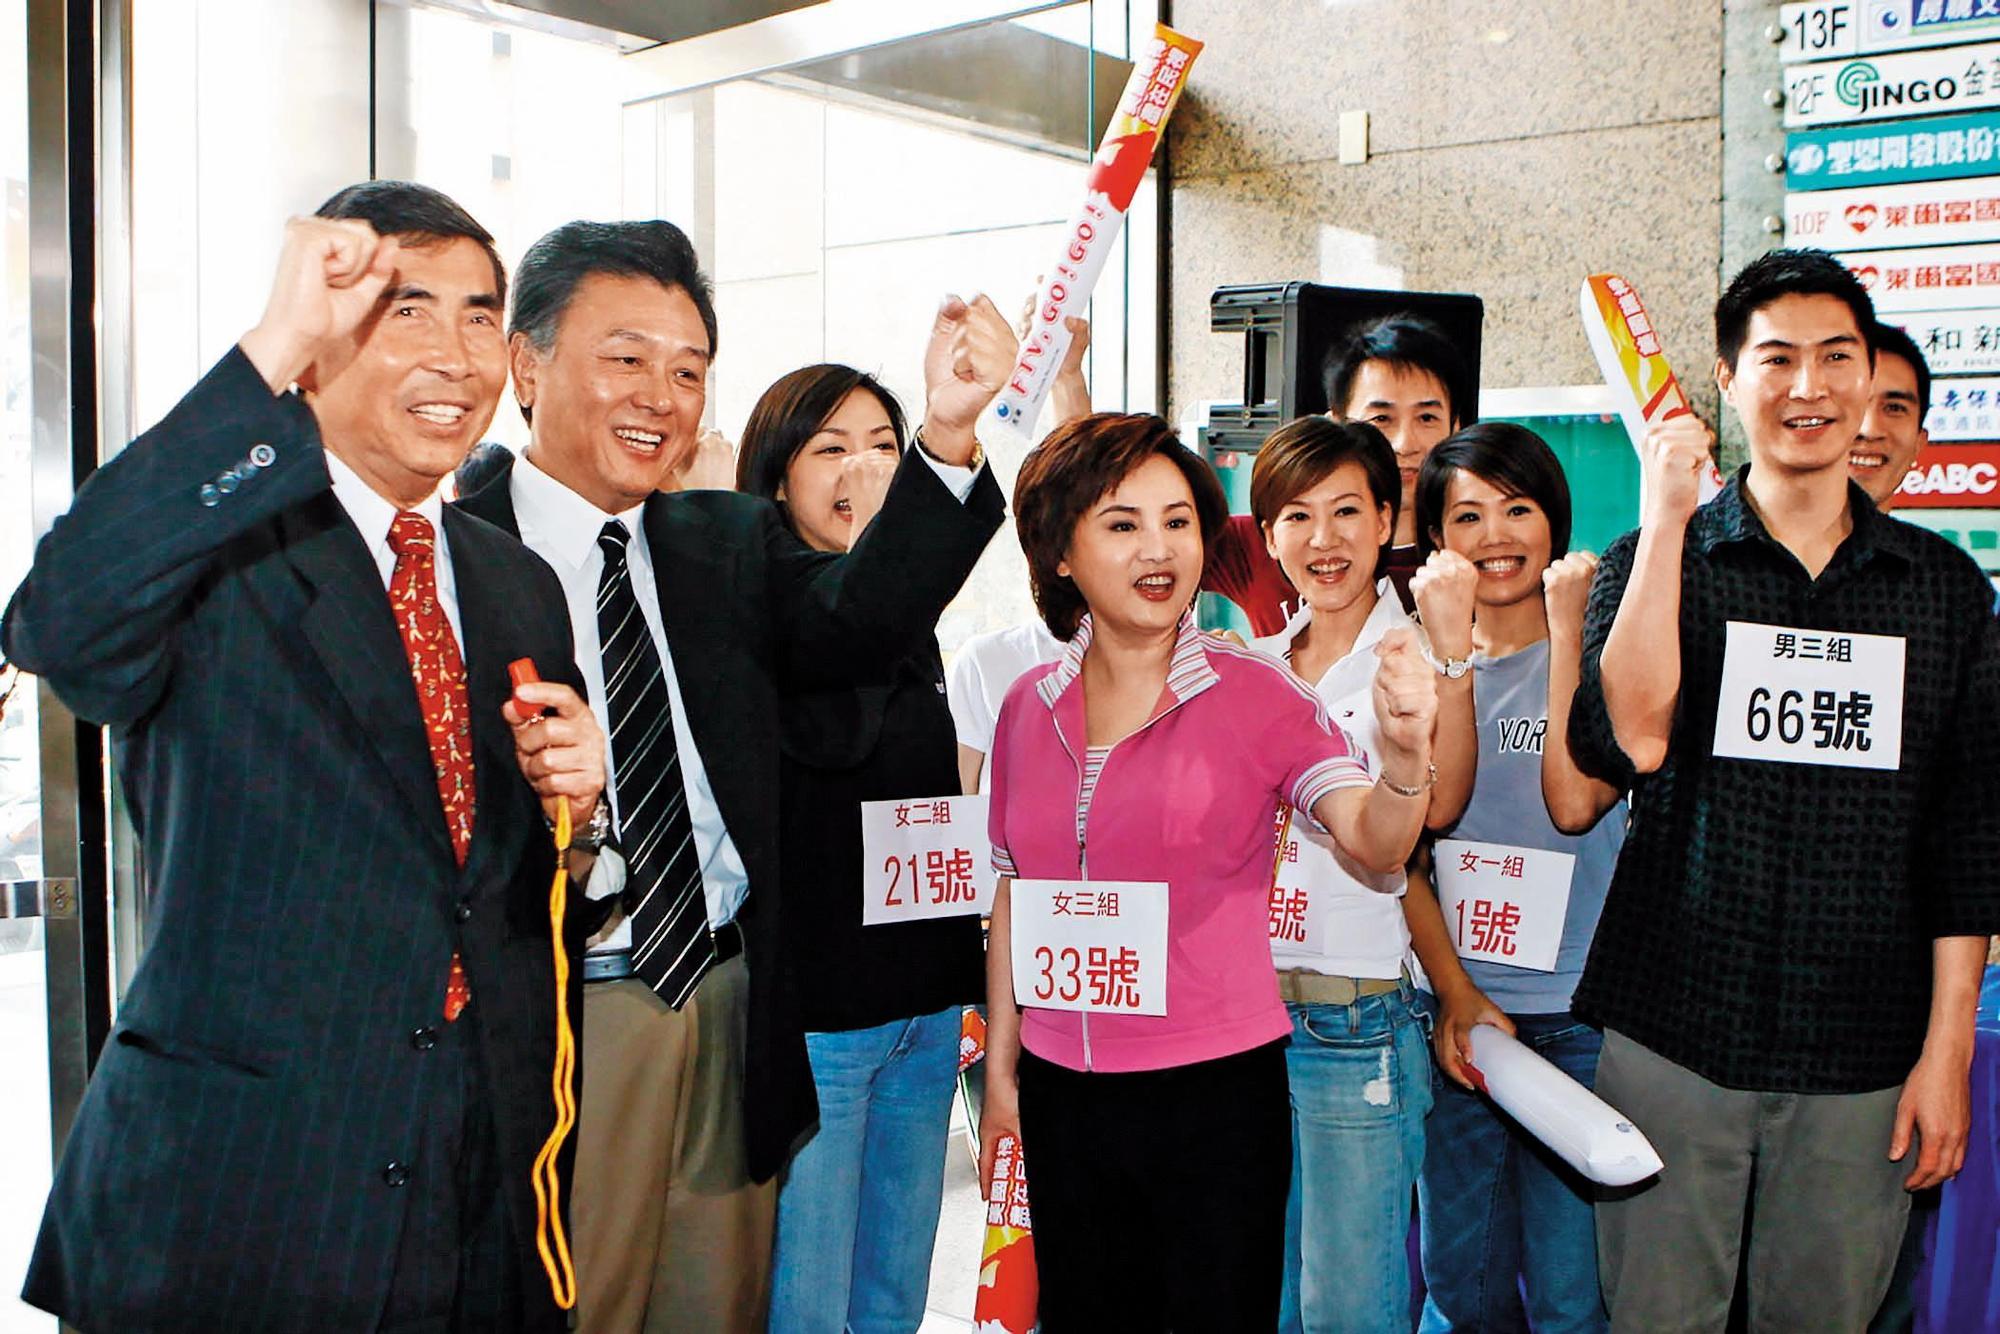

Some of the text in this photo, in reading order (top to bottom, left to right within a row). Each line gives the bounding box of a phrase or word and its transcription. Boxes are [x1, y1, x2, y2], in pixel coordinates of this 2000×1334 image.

[1794, 6, 1849, 51] 13F
[1791, 75, 1825, 115] 12F
[1860, 77, 1957, 114] JINGO
[1792, 211, 1830, 236] 10F
[1773, 633, 1852, 663] 男三組
[1747, 687, 1873, 752] 66號
[895, 801, 952, 827] 女二組
[885, 847, 976, 906] 21號
[1459, 850, 1525, 878] 女一組
[1052, 891, 1120, 917] 女三組
[1034, 946, 1140, 1007] 33號
